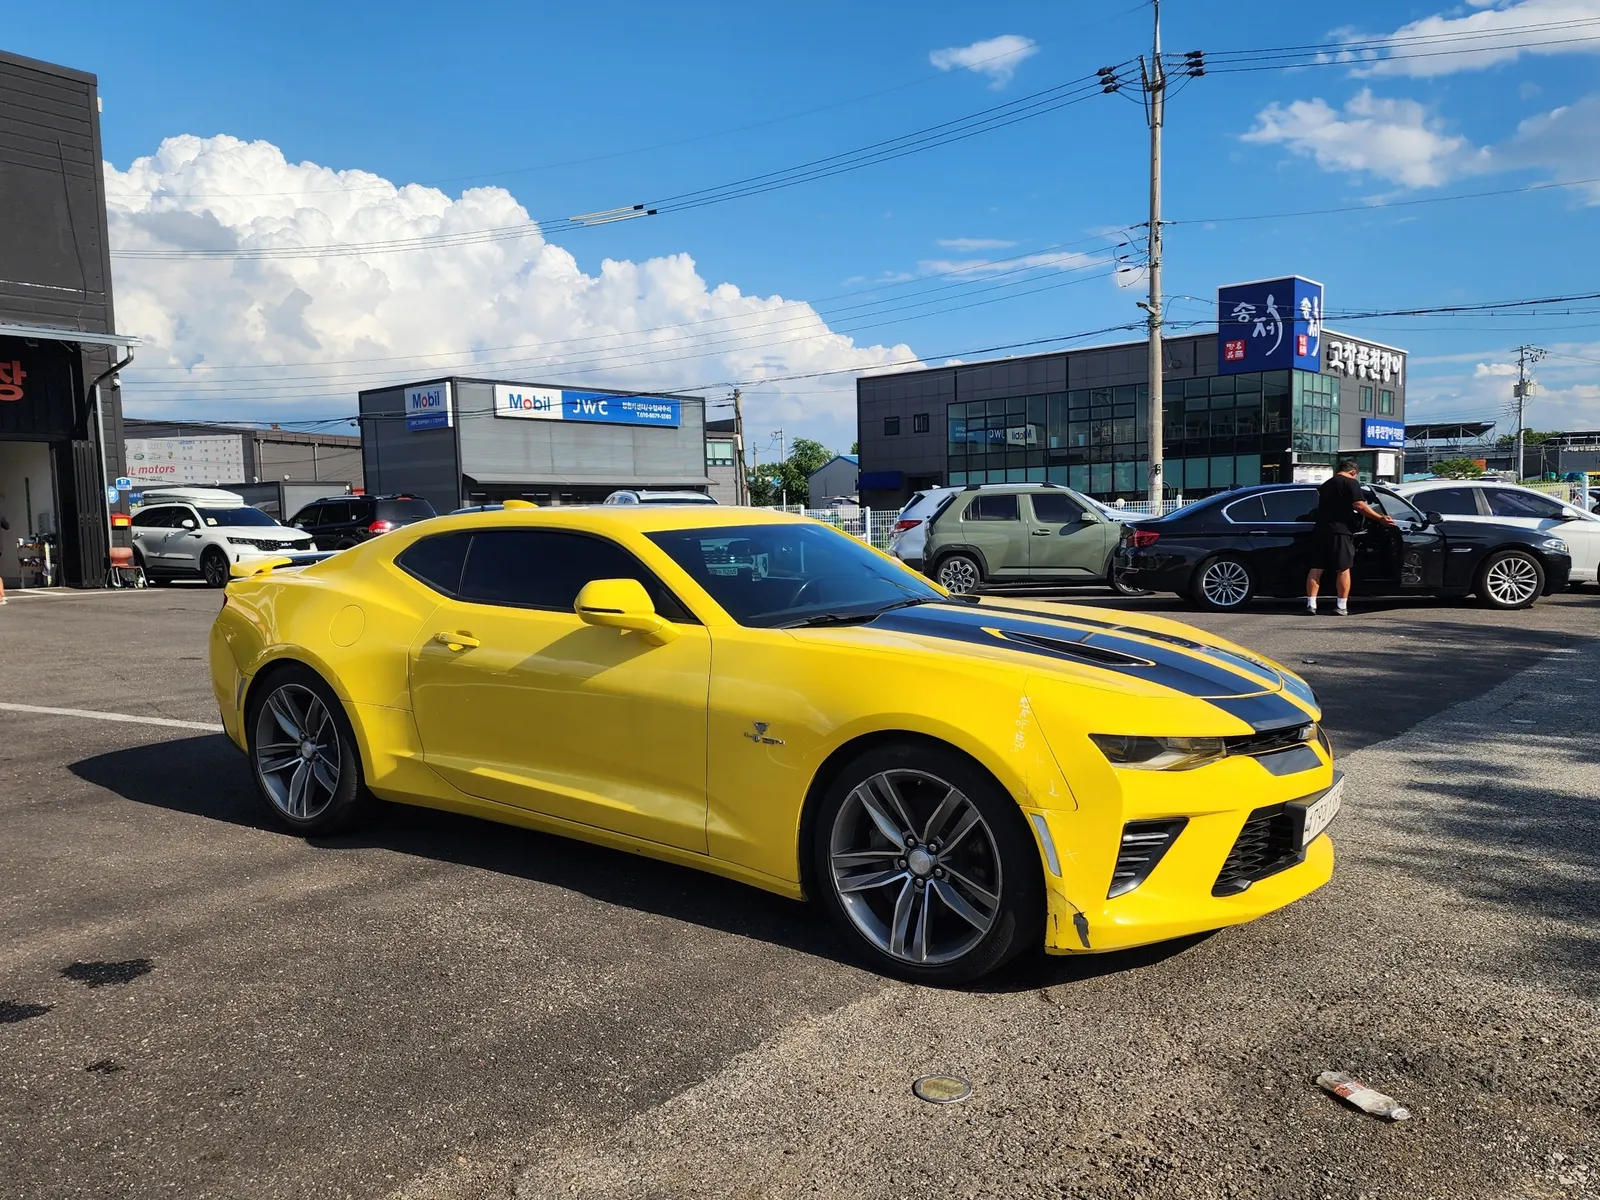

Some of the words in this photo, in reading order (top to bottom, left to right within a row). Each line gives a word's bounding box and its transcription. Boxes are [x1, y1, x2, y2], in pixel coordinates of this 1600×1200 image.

[1329, 341, 1402, 386] 고창풍천장어
[412, 391, 440, 409] Mobil
[508, 393, 551, 412] Mobil
[572, 399, 609, 416] JWC
[138, 464, 176, 475] motors
